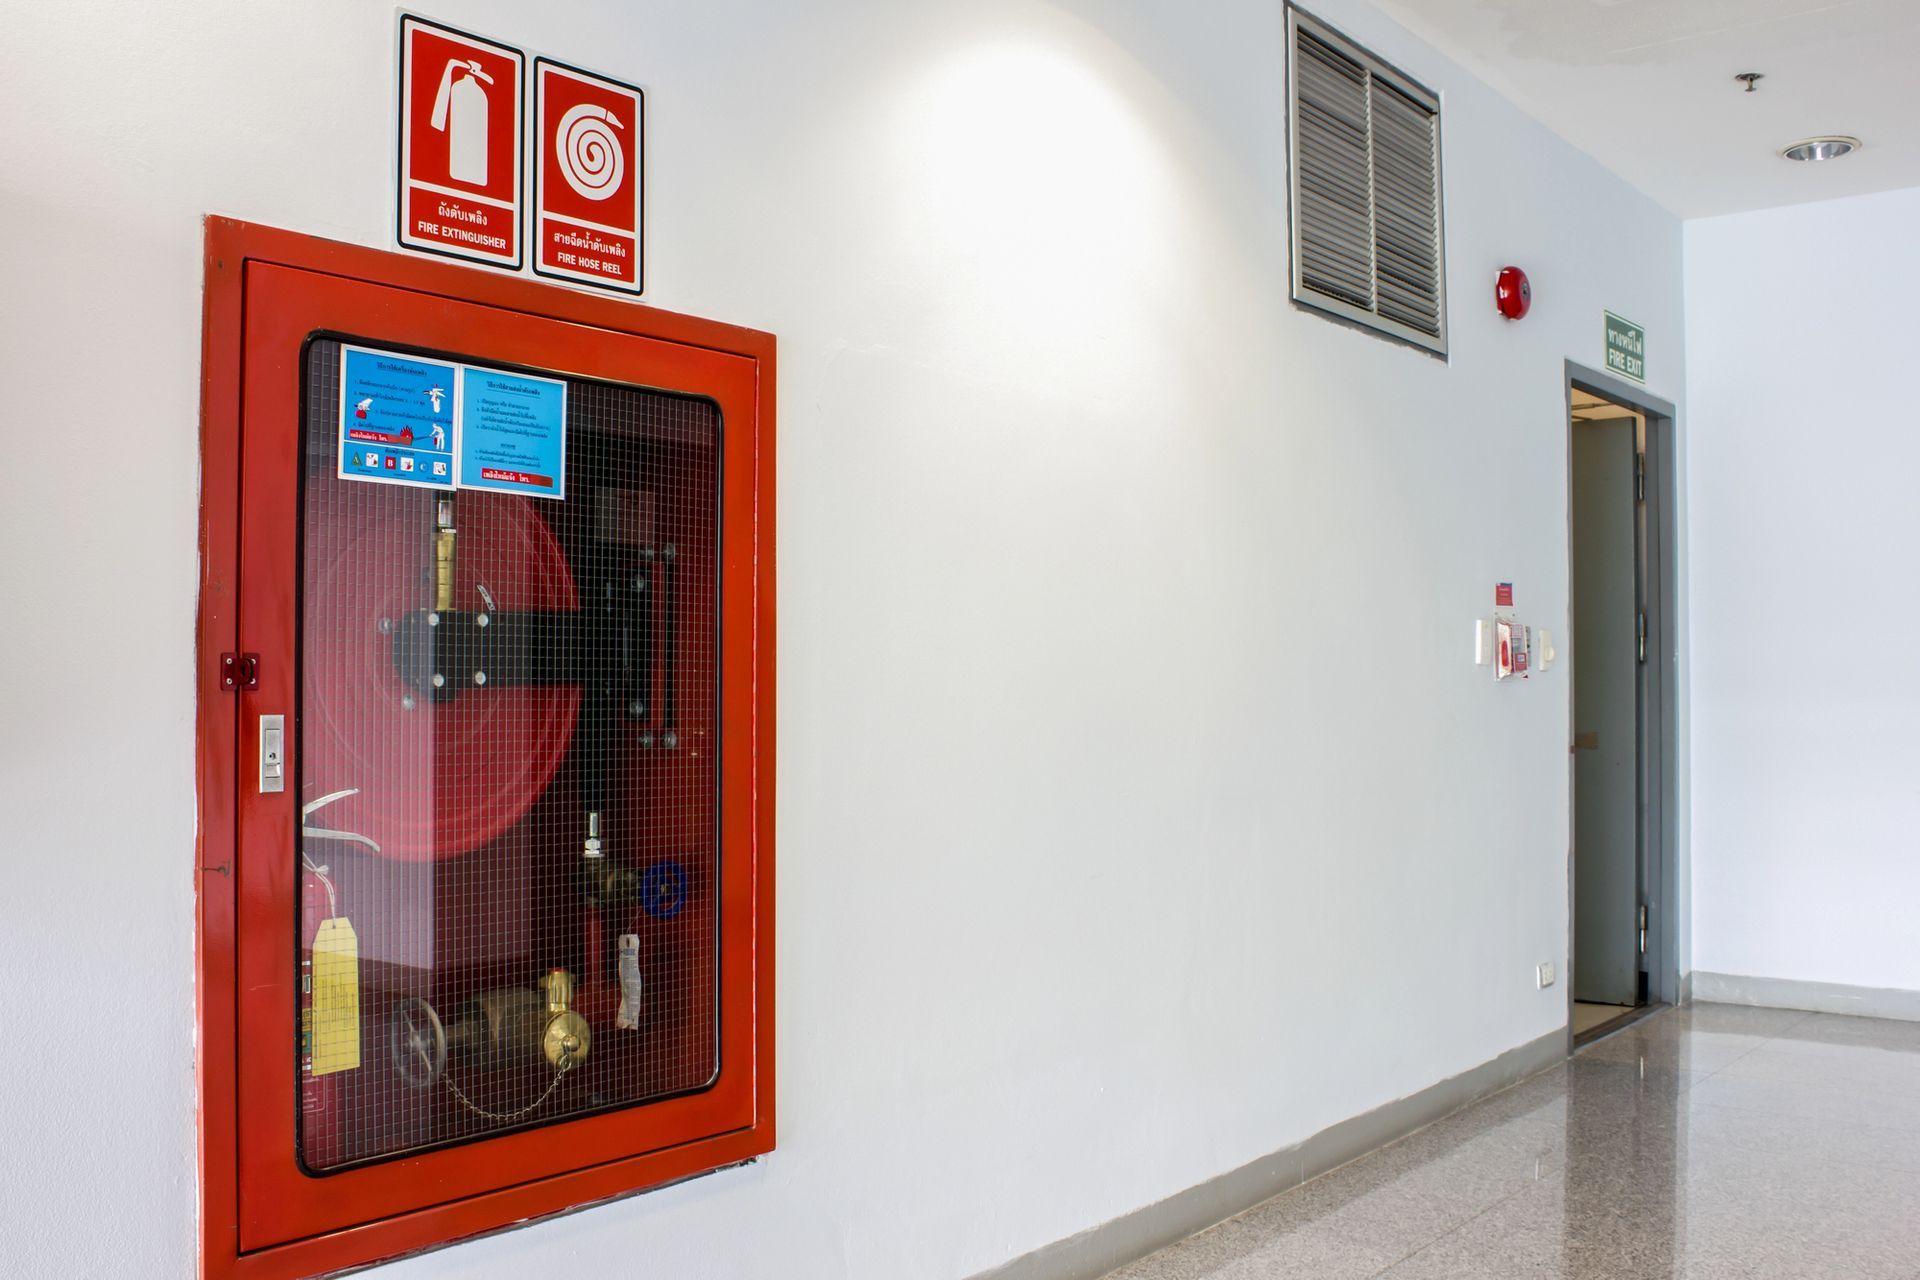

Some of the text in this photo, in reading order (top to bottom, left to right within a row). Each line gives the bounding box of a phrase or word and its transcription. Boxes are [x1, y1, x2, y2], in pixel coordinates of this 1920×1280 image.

[438, 201, 488, 226] ถังดับเพลิง
[418, 221, 507, 250] FIRE EXTINGUISHER
[553, 231, 626, 258] สายฉีดน้ำดับเพลิง
[557, 251, 623, 275] FIRE HOSE REEL
[1608, 329, 1642, 355] ทางหนีไฟ
[1609, 348, 1642, 376] FIRE EXIT
